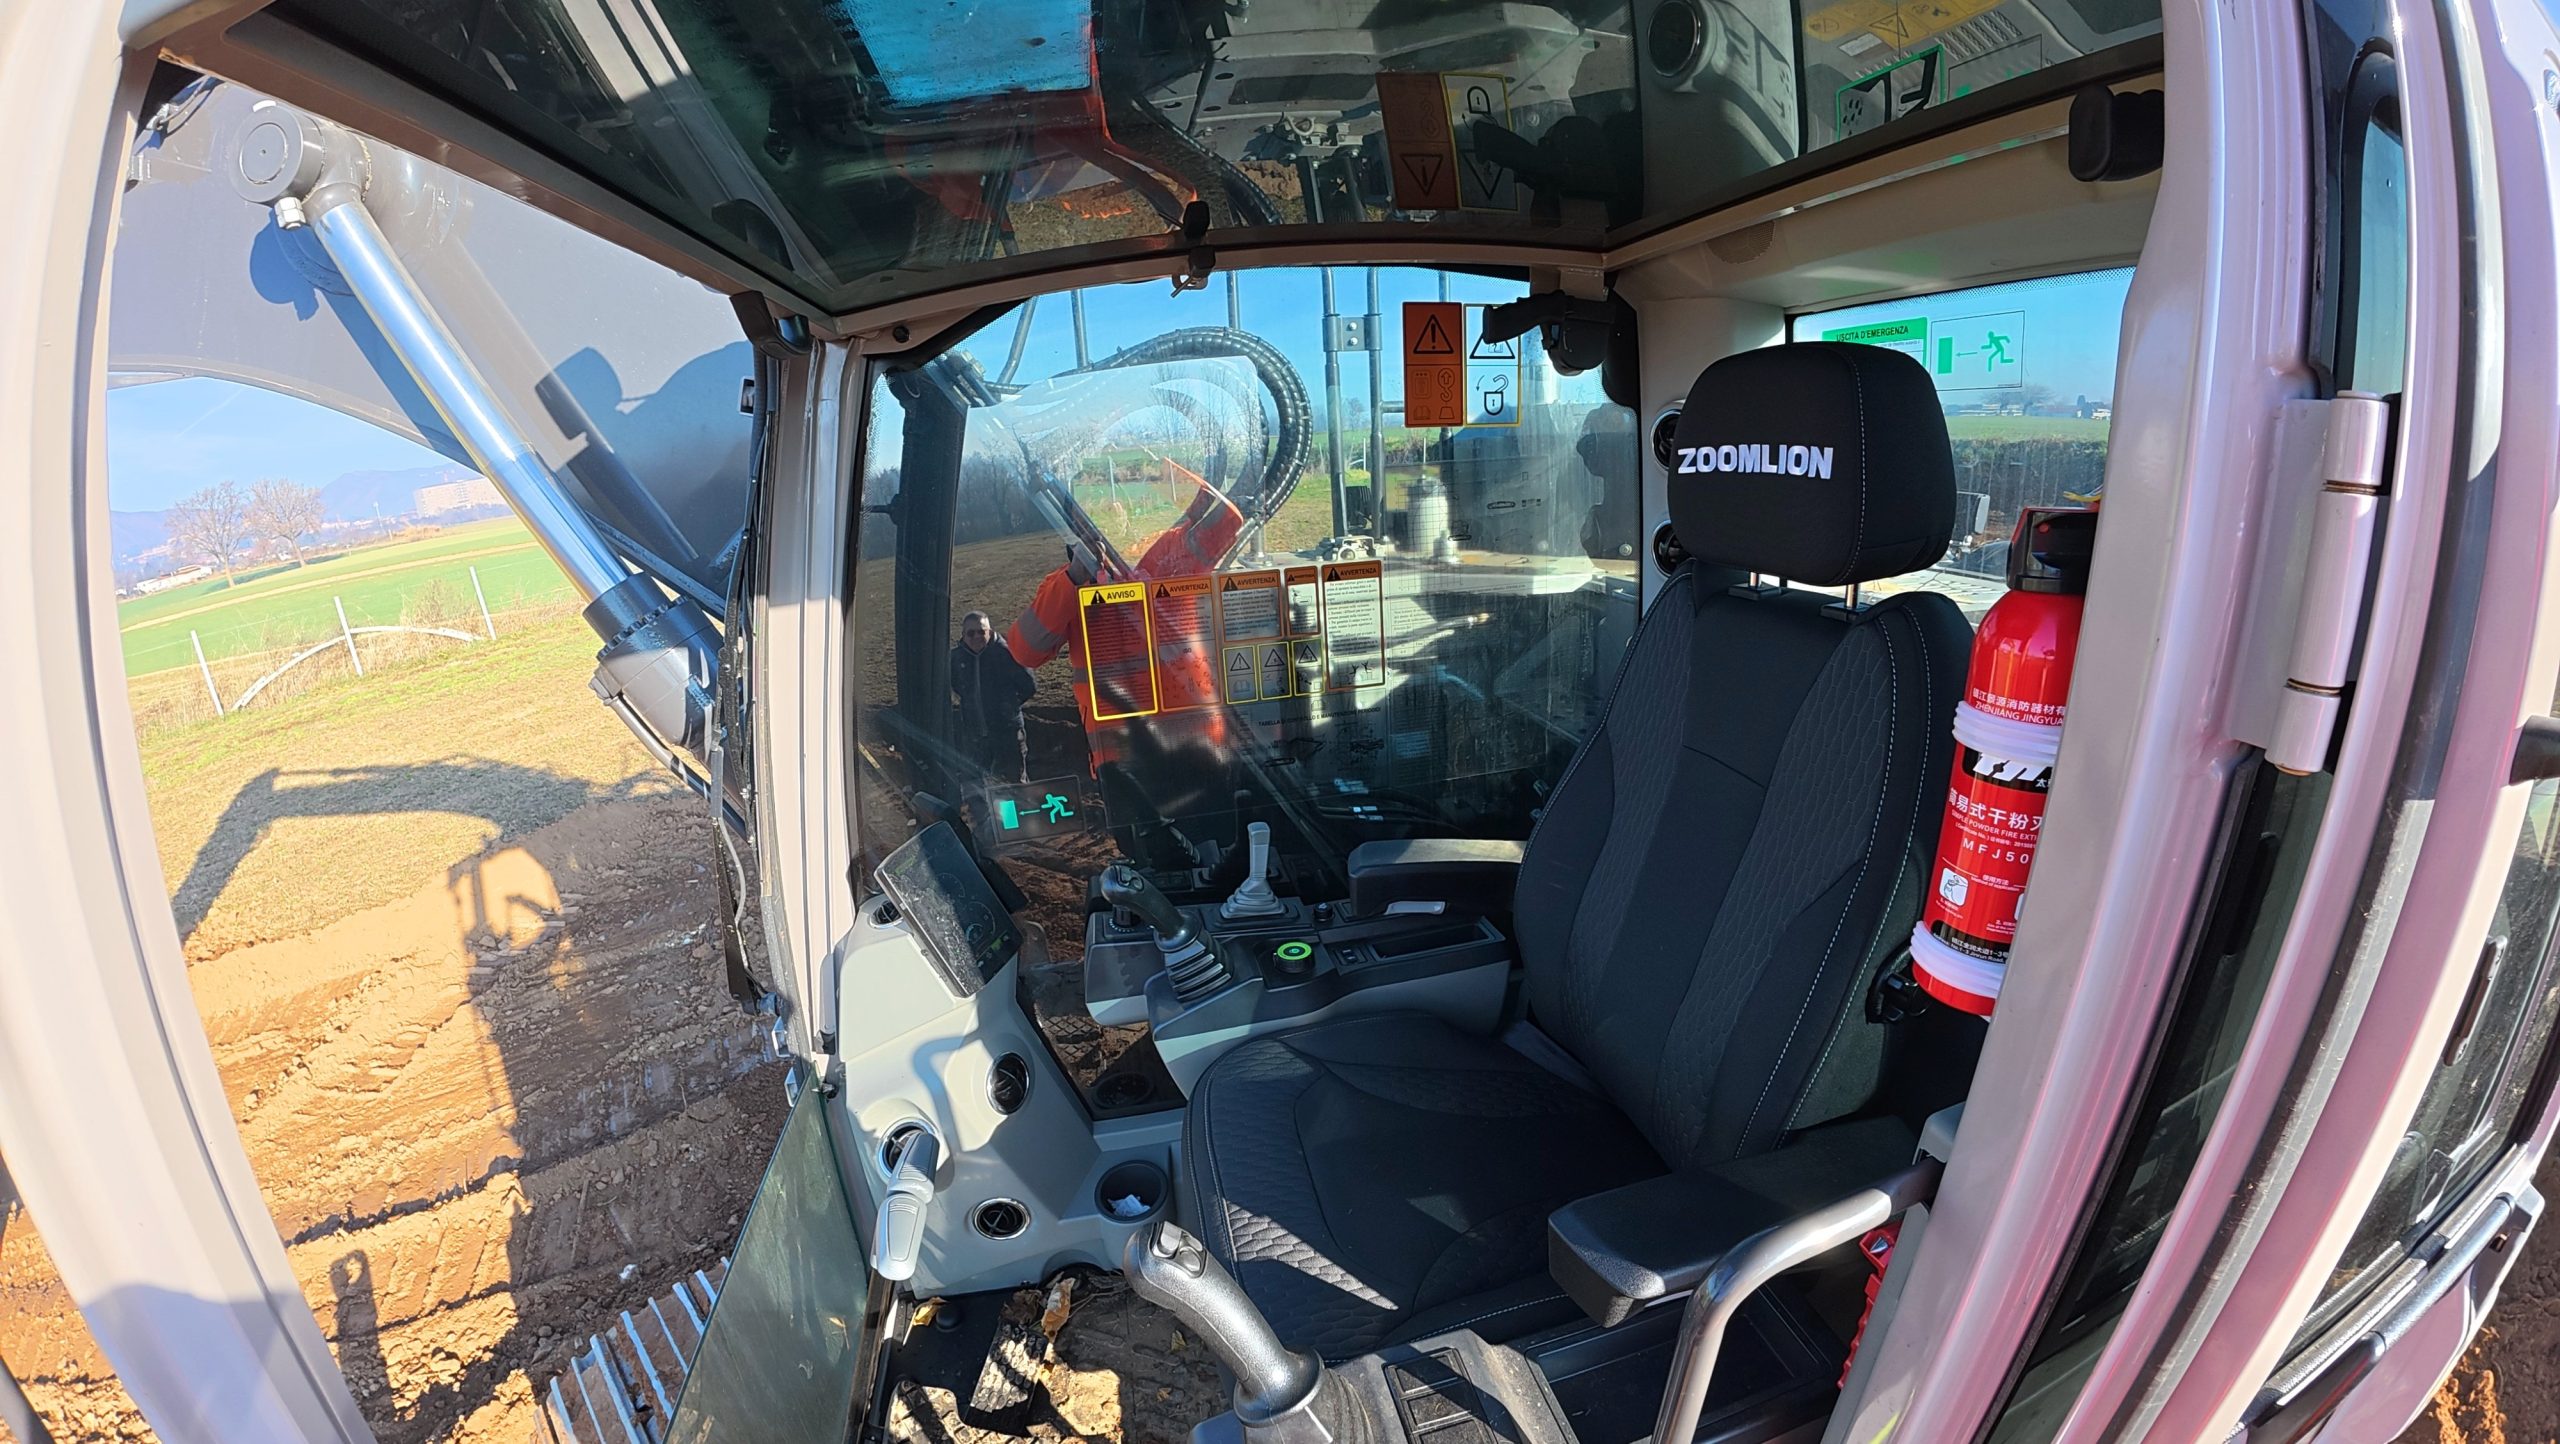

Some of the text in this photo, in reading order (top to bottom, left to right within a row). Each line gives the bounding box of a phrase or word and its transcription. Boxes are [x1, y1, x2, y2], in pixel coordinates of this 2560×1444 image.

[1836, 326, 1909, 342] USCITA D'EMERGENZA
[1677, 443, 1834, 480] ZOOMLION
[1340, 567, 1377, 577] AVVERTENZA
[1237, 576, 1276, 587] AVVERTENZA
[1169, 583, 1210, 593] AVVERTENZA
[1106, 589, 1137, 601] AVVISO
[1975, 701, 2020, 721] ZHENJIANG
[2034, 778, 2051, 789] 太
[1969, 818, 2000, 836] POWDER
[2001, 829, 2018, 839] FIRE
